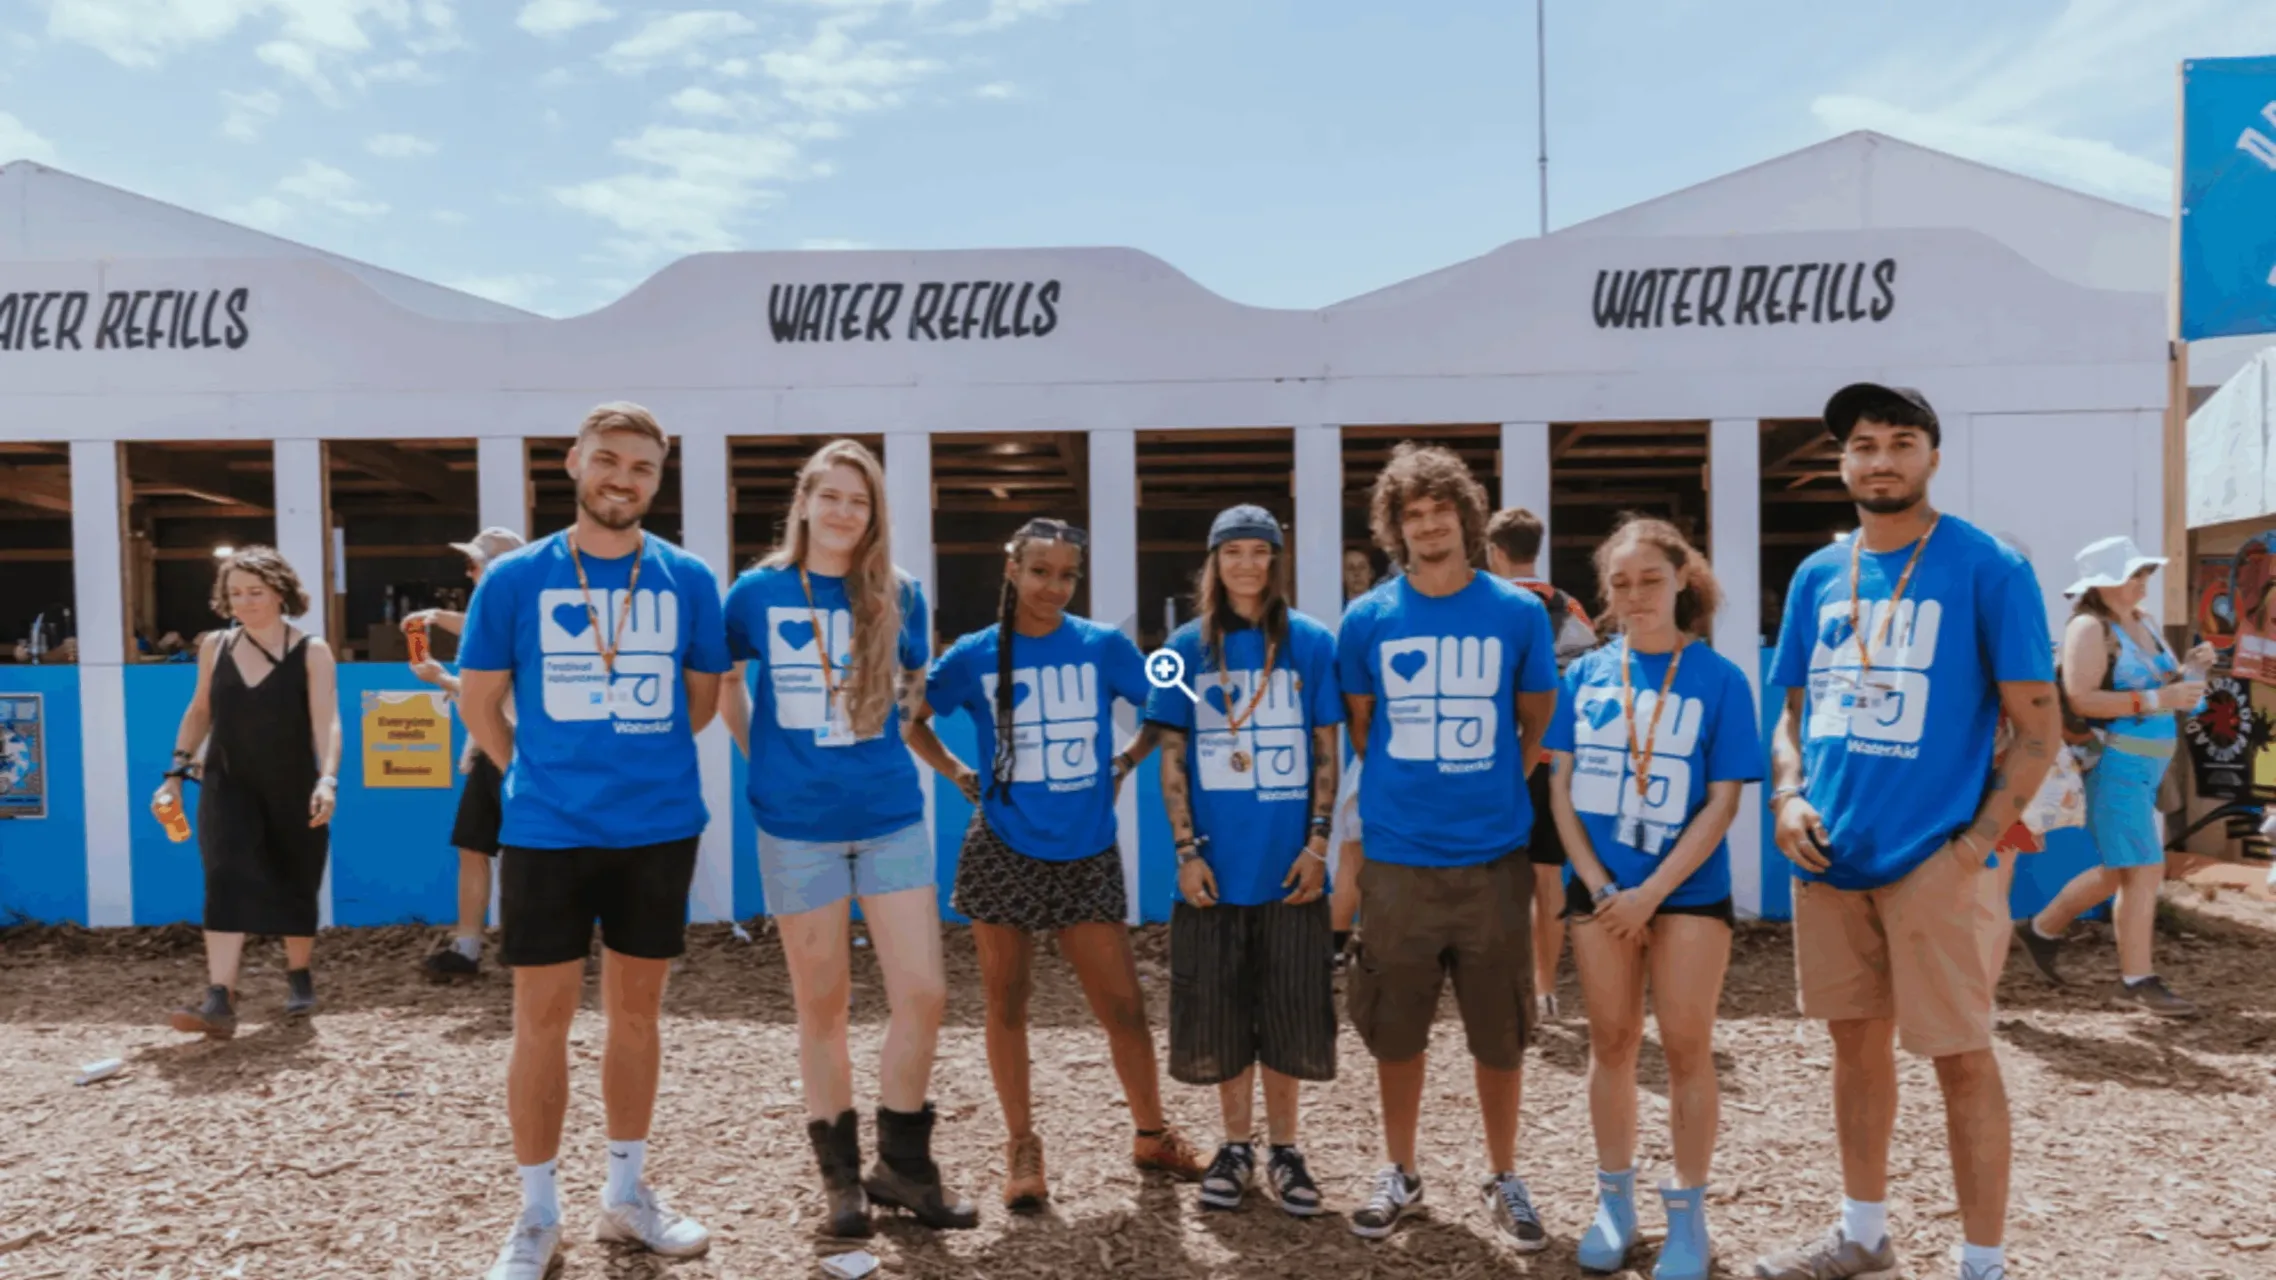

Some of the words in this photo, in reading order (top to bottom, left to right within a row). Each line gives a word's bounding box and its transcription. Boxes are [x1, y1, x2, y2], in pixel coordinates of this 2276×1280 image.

[0, 291, 89, 350] ATER
[95, 288, 249, 350] REFILLS
[768, 282, 904, 343] WATER
[907, 279, 1061, 341] REFILLS
[1593, 264, 1732, 329] WATER
[1733, 258, 1896, 326] REFILLS
[377, 715, 437, 732] Everyone
[1846, 739, 1920, 759] WaterAid
